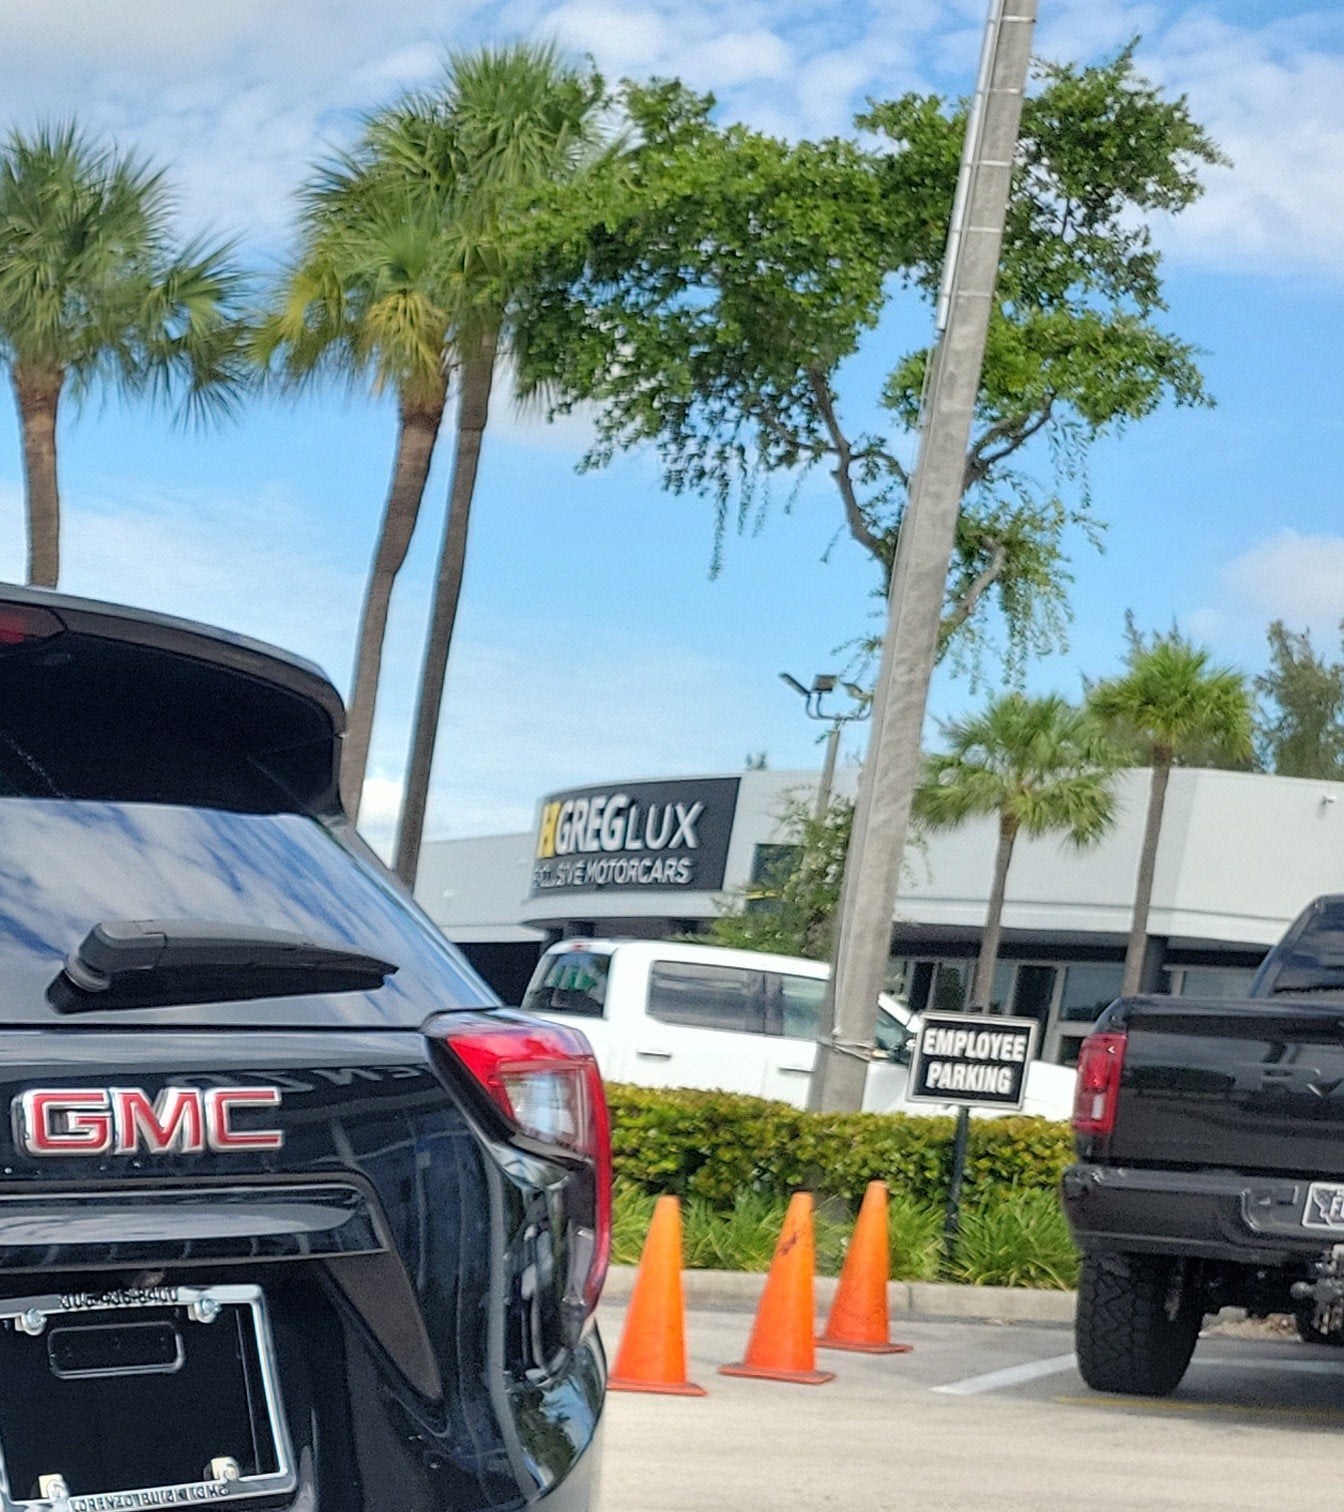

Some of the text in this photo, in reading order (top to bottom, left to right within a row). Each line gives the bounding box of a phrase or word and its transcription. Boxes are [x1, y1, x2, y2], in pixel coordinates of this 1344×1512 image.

[587, 856, 694, 885] MOTORCARS
[922, 1027, 1027, 1062] EMPLOYEE
[925, 1060, 1014, 1095] PARKING
[14, 1087, 283, 1156] GMC
